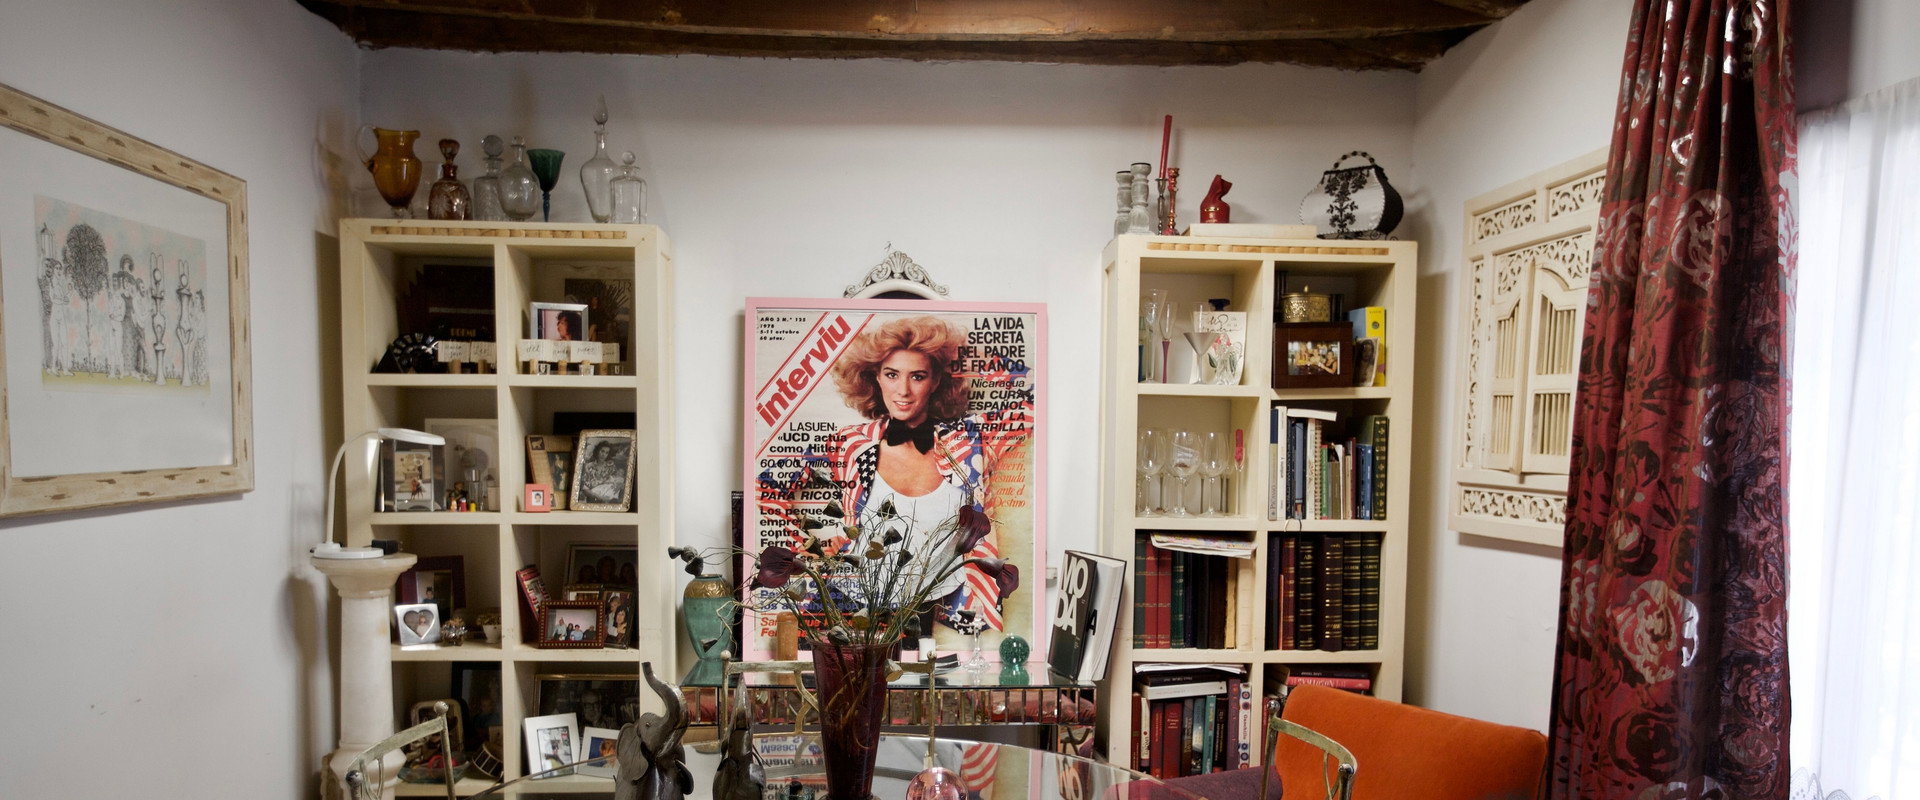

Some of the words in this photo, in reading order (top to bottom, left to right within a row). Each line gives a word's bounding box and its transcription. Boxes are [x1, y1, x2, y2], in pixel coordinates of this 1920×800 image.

[974, 317, 991, 330] LA
[993, 316, 1025, 330] VIDA
[967, 331, 1025, 344] SECRETA
[957, 345, 980, 359] DEL
[984, 345, 1026, 358] PADRE
[951, 359, 968, 373] DE
[971, 359, 1026, 373] FRANCO
[970, 378, 1026, 389] Nicaragua
[967, 390, 985, 400] UN
[989, 390, 1026, 400] CURA
[967, 399, 1026, 411] ESPAÑOL
[986, 411, 1004, 421] EN
[1008, 411, 1026, 421] LA
[789, 422, 838, 431] LASUEN:
[955, 422, 1026, 432] GUERRILLA
[778, 432, 810, 442] «UCD
[814, 432, 848, 442] actúa
[769, 445, 804, 453] como
[808, 443, 846, 453] Hitler»
[804, 459, 848, 468] millones
[760, 471, 774, 479] en
[760, 491, 796, 501] PARA
[760, 506, 782, 516] Los
[760, 529, 800, 538] contra
[760, 538, 797, 548] Ferrer
